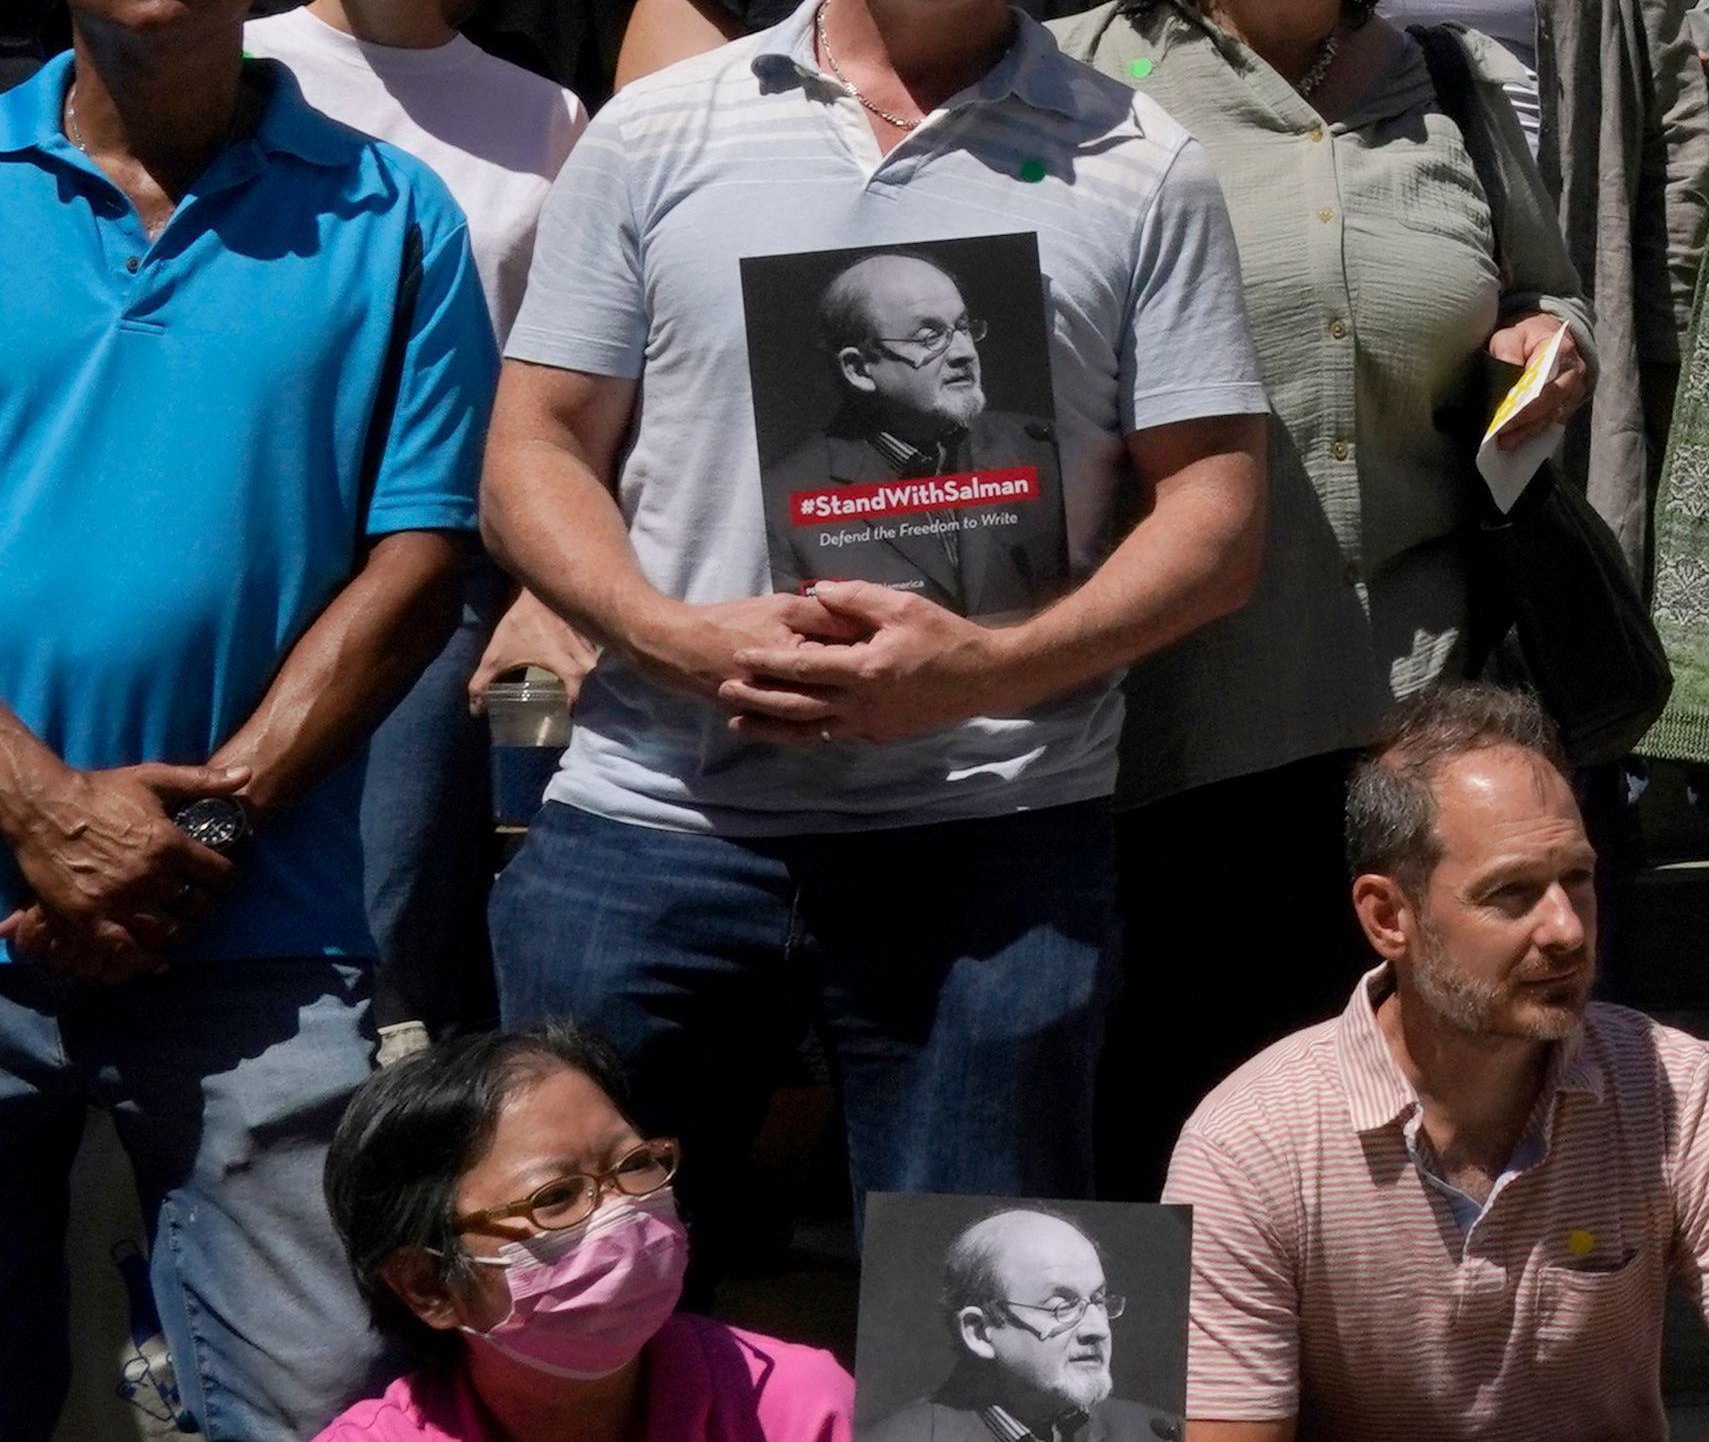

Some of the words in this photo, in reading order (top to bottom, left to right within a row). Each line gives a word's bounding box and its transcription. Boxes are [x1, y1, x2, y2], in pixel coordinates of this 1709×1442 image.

[800, 476, 1030, 517] #StandWithSalman
[819, 526, 870, 548] Defend
[874, 526, 896, 539] the
[899, 519, 960, 537] Freedom
[963, 516, 978, 529] to
[980, 511, 1018, 526] Write
